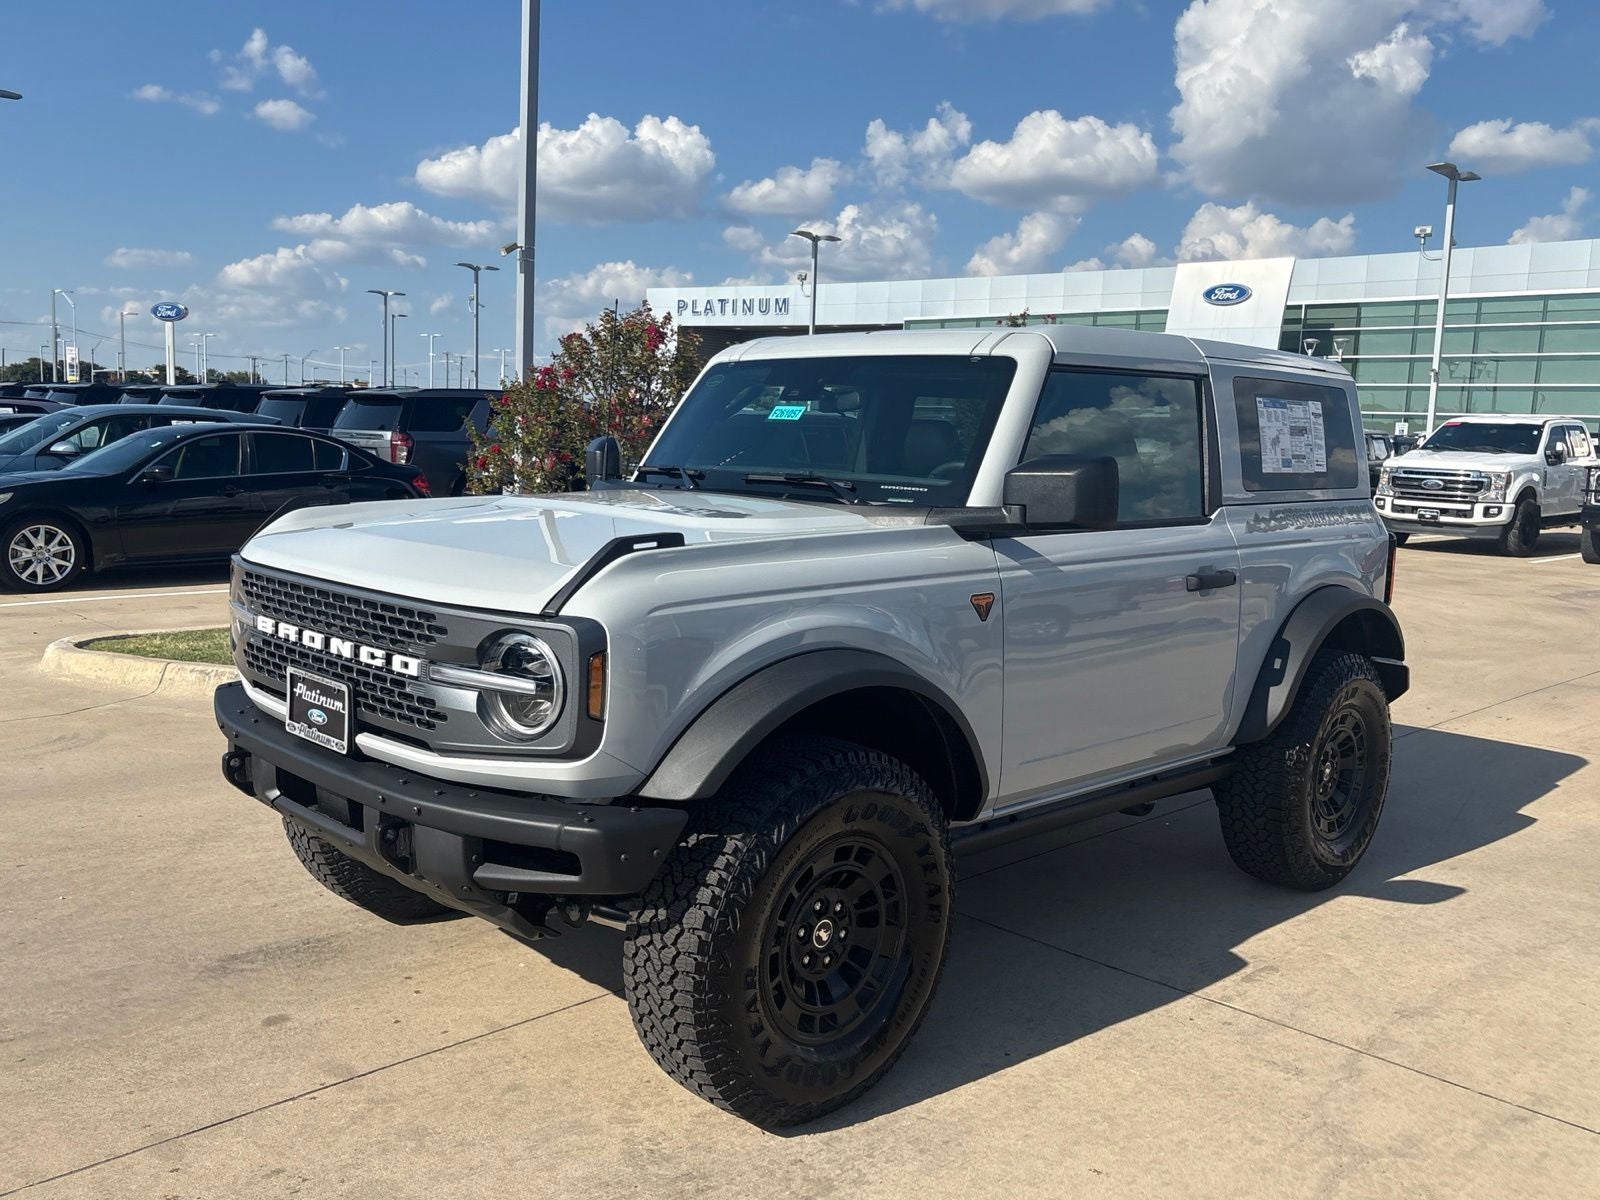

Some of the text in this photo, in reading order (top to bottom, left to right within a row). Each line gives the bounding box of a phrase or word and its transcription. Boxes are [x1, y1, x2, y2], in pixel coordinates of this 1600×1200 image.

[1211, 287, 1240, 300] Ford
[156, 305, 177, 317] Ford
[677, 298, 790, 316] PLATINUM
[256, 615, 423, 677] BRONCO
[293, 682, 346, 714] Platinum
[297, 722, 336, 748] Platinum
